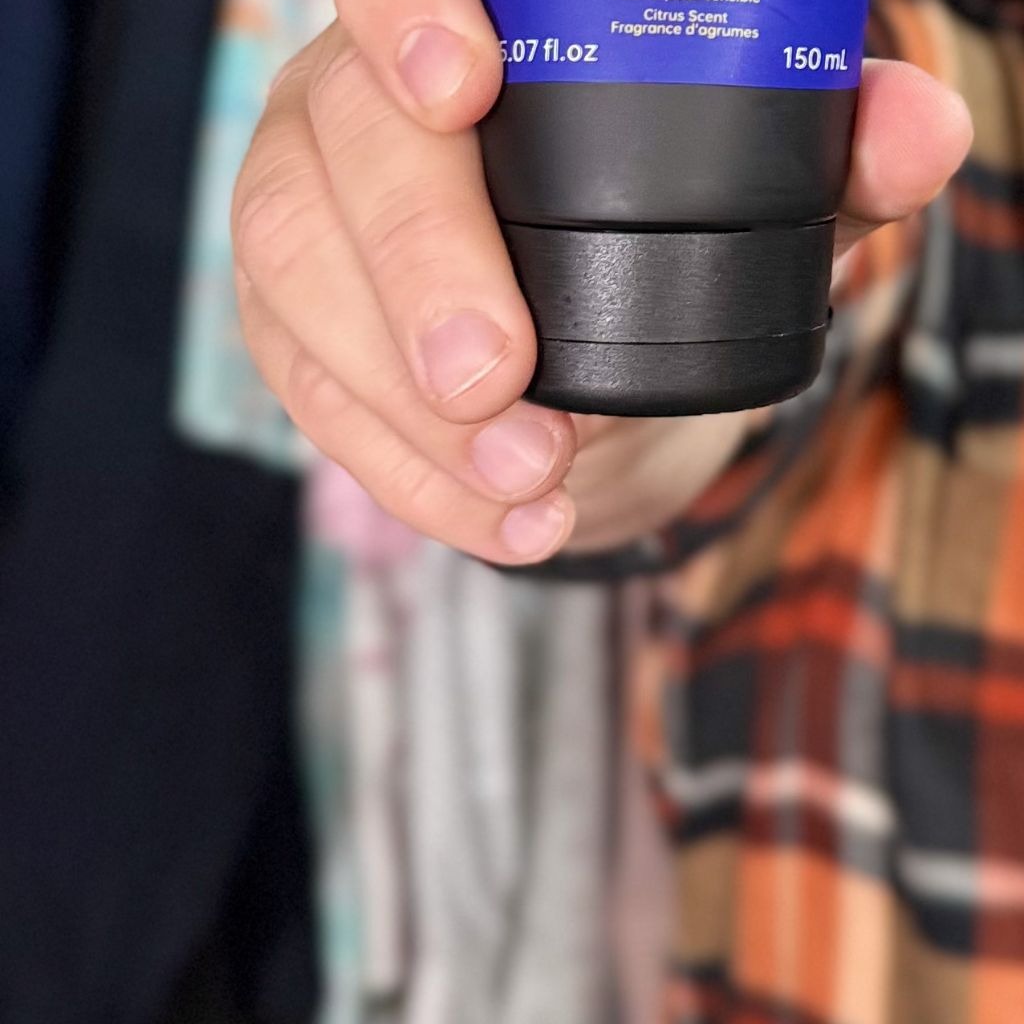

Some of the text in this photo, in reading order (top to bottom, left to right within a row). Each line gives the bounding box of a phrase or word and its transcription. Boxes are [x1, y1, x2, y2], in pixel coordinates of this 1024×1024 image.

[643, 8, 728, 24] Citrus Scent
[610, 21, 759, 40] Fragrance d'agrumes
[544, 38, 599, 63] fl.oz
[783, 46, 848, 70] 150 mL
